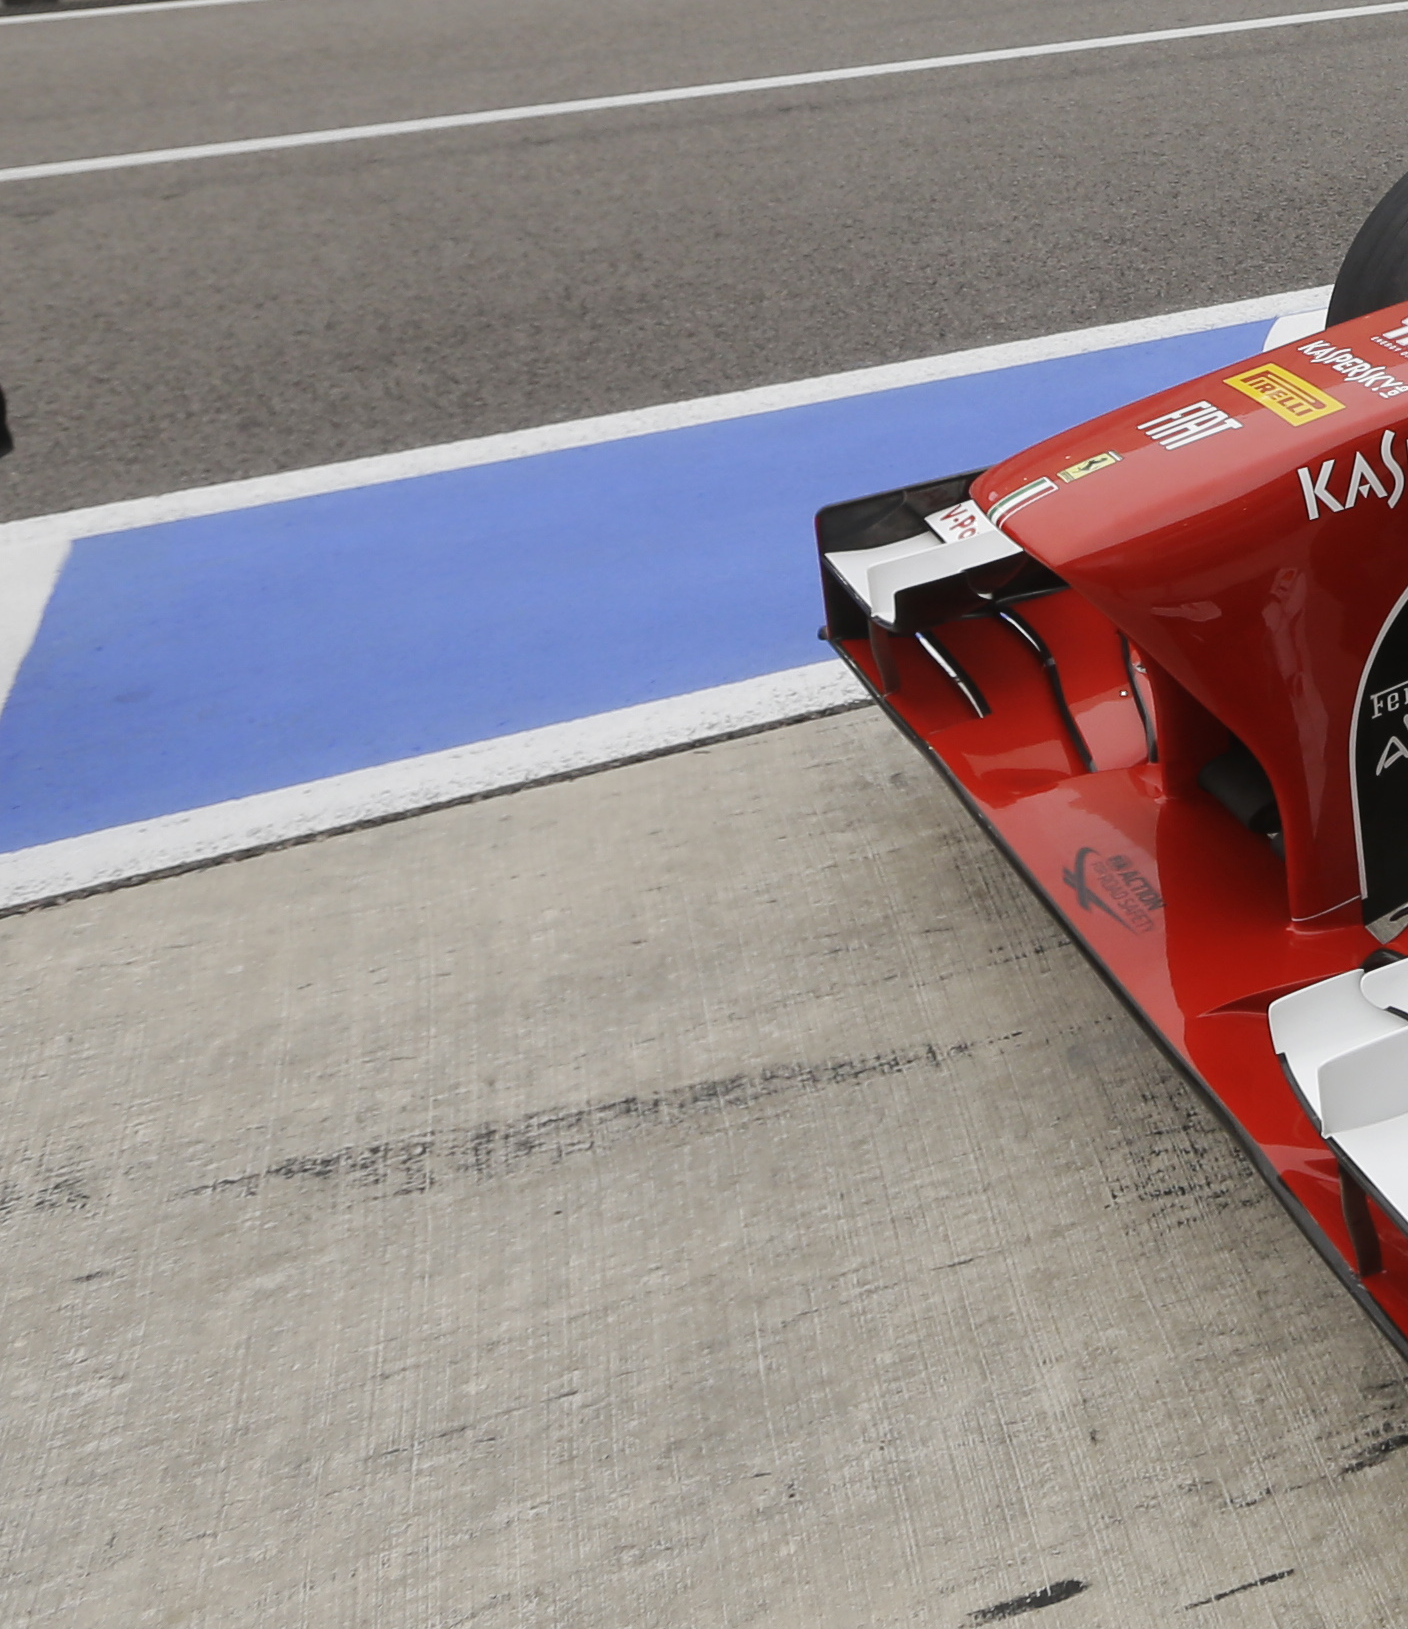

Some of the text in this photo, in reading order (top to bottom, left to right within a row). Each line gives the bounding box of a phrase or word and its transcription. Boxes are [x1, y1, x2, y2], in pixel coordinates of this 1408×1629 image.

[1297, 339, 1404, 392] KASPERSKY
[1239, 370, 1328, 417] PIRELLI
[1136, 398, 1244, 452] FIAT
